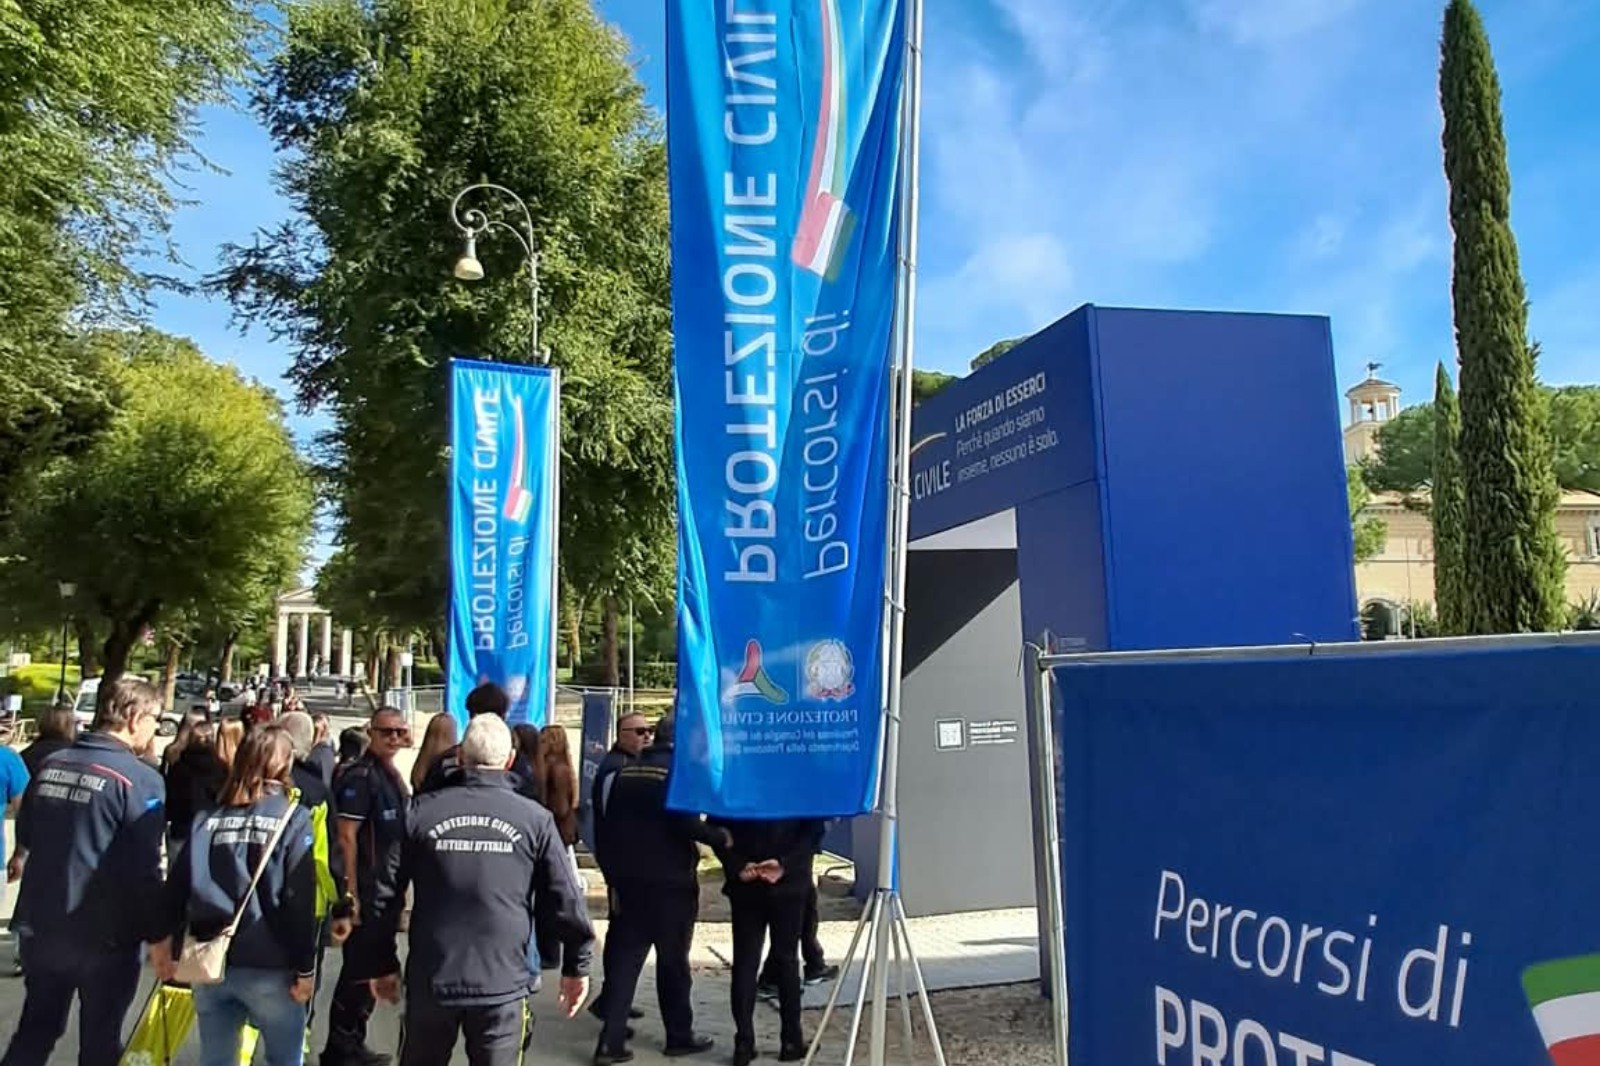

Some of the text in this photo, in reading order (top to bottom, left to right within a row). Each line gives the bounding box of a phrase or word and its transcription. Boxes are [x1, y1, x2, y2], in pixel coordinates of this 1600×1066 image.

[955, 372, 1046, 433] LA FORZA DI ESSERCI
[983, 419, 1016, 449] quando
[1016, 406, 1046, 431] siamo
[989, 442, 1027, 469] nessuno
[914, 460, 951, 500] CIVILE
[428, 815, 523, 843] PROTEZIONE CIVILE
[1153, 869, 1472, 1027] Percorsi di
[1154, 985, 1378, 1066] PROT
